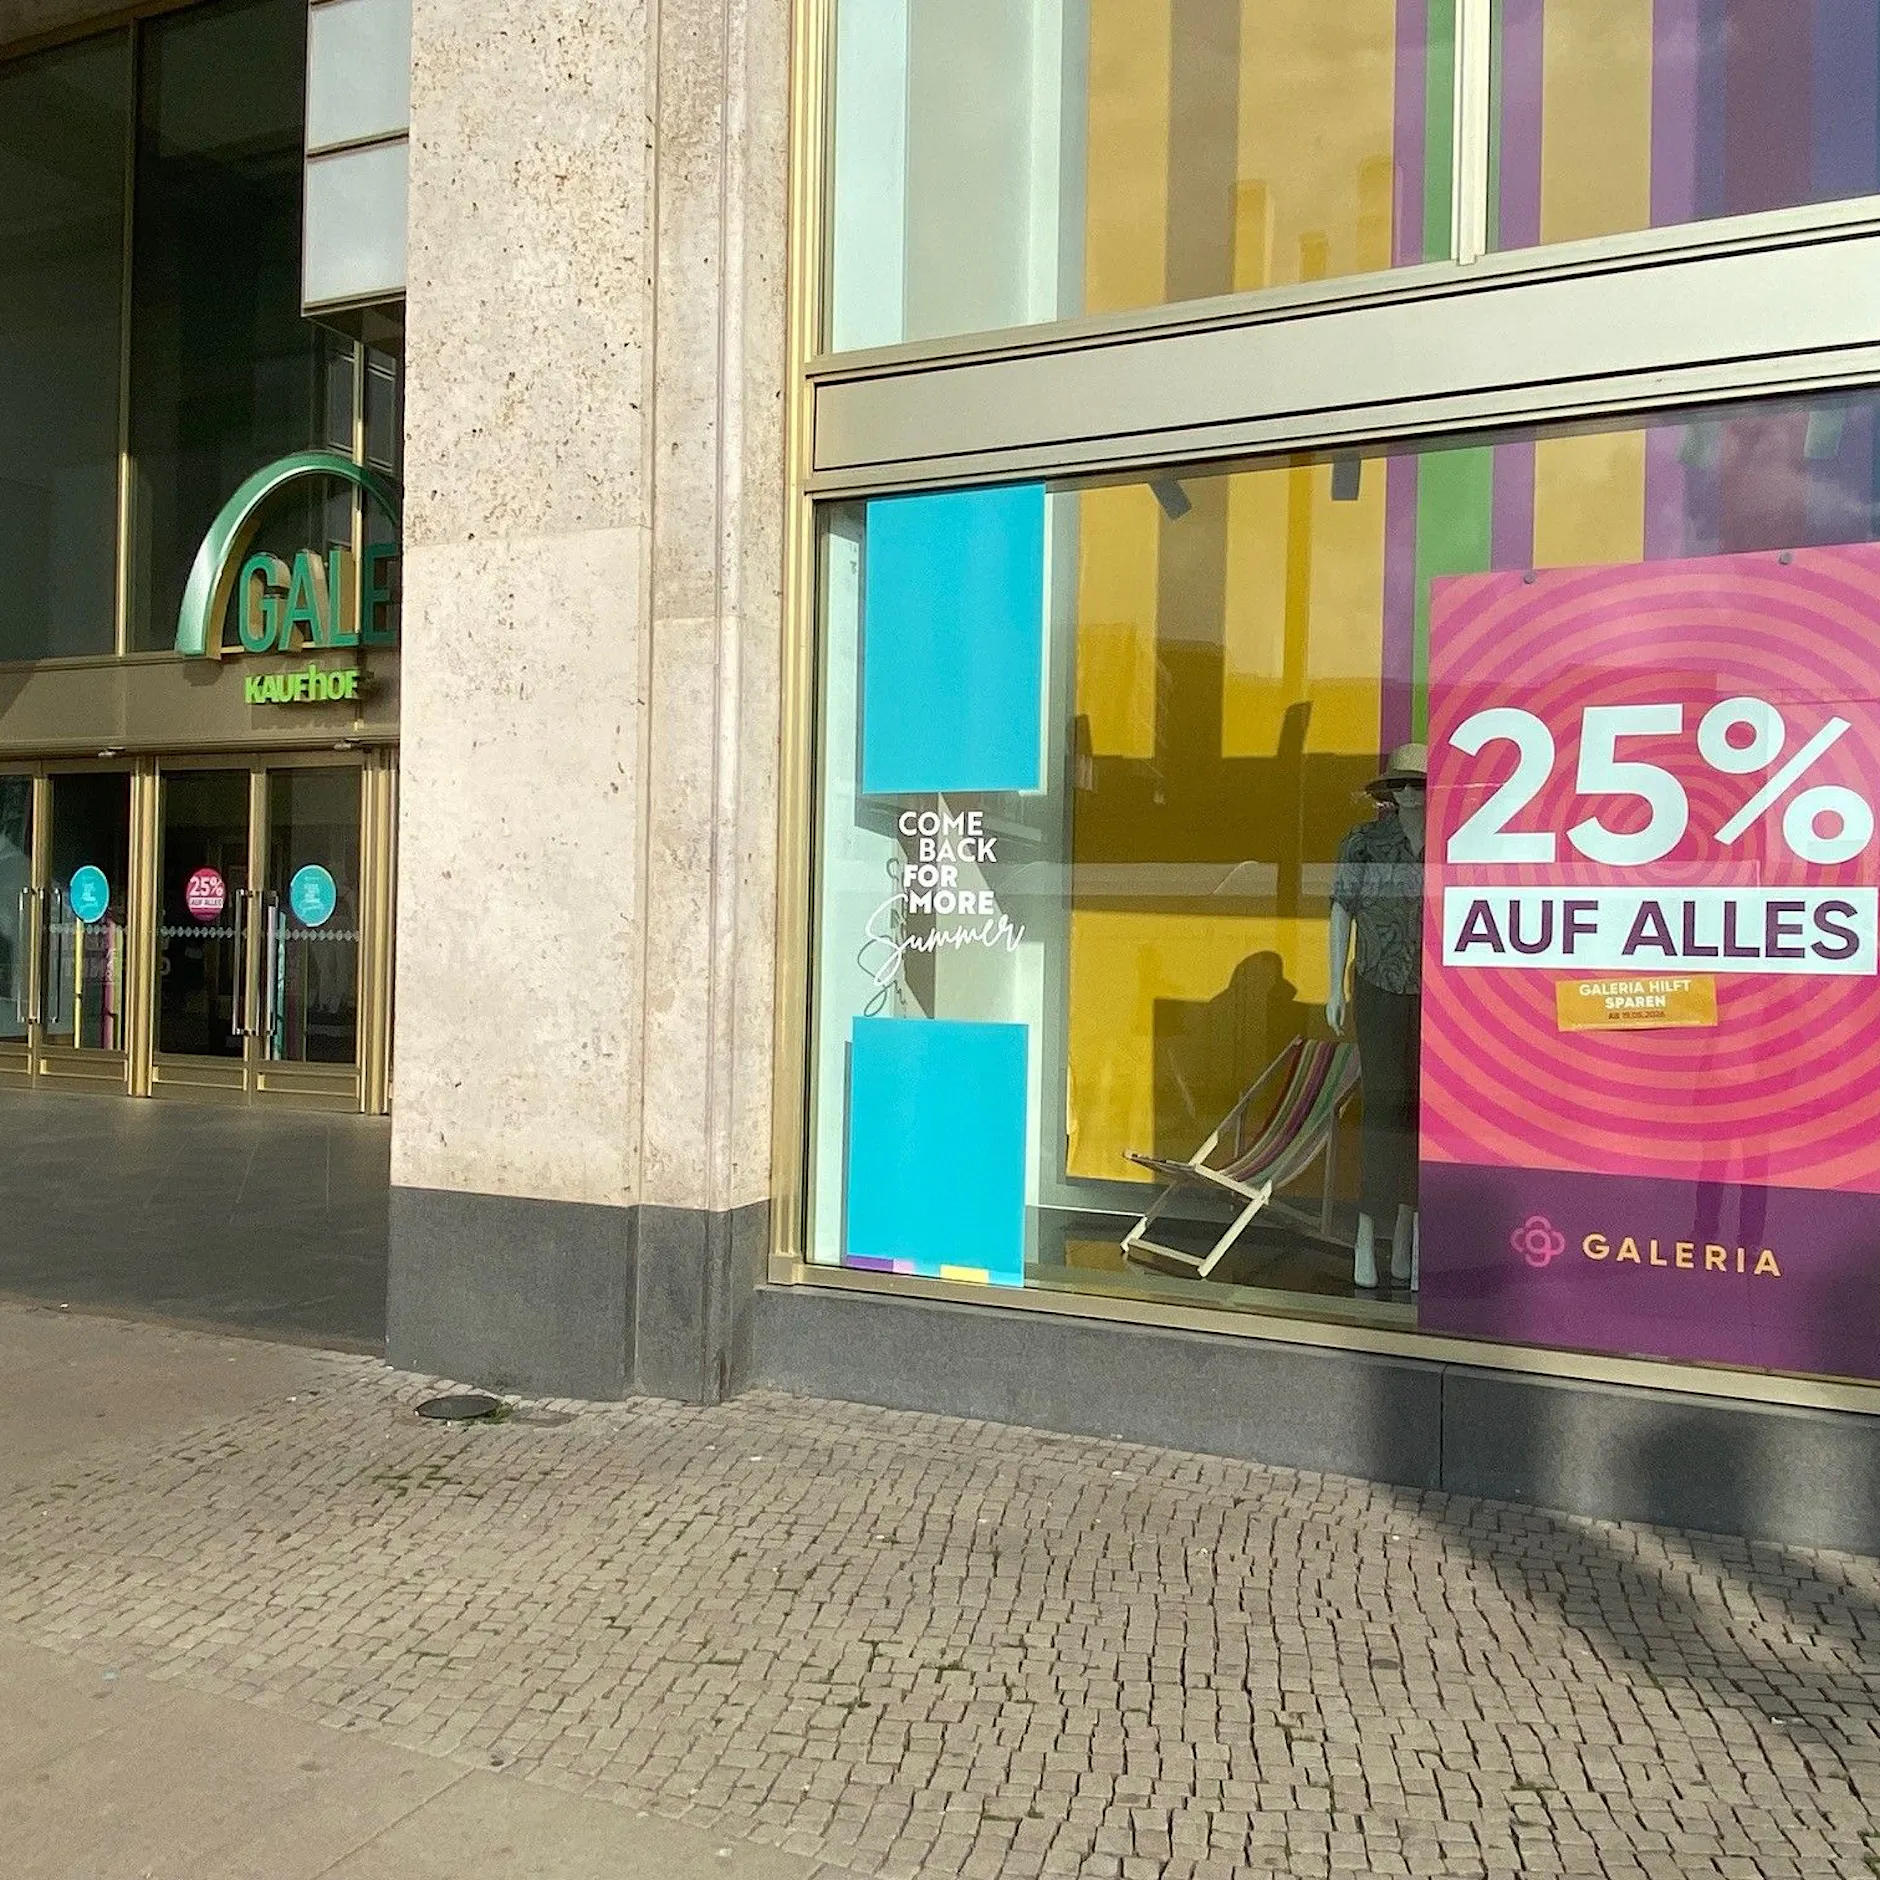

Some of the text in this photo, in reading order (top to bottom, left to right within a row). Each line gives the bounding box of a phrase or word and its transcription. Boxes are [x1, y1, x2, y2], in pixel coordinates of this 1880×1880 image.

[1447, 696, 1875, 866] 25%
[898, 811, 983, 837] COME
[919, 838, 997, 863] BACK
[189, 876, 223, 896] 25%
[904, 864, 958, 888] FOR
[909, 890, 995, 915] MORE
[864, 893, 1026, 986] Summer
[1454, 899, 1860, 960] AUF ALLES
[1579, 979, 1692, 997] GALERIA HILFT
[1604, 995, 1667, 1009] SPAREN
[1582, 1233, 1782, 1278] GALERIA
